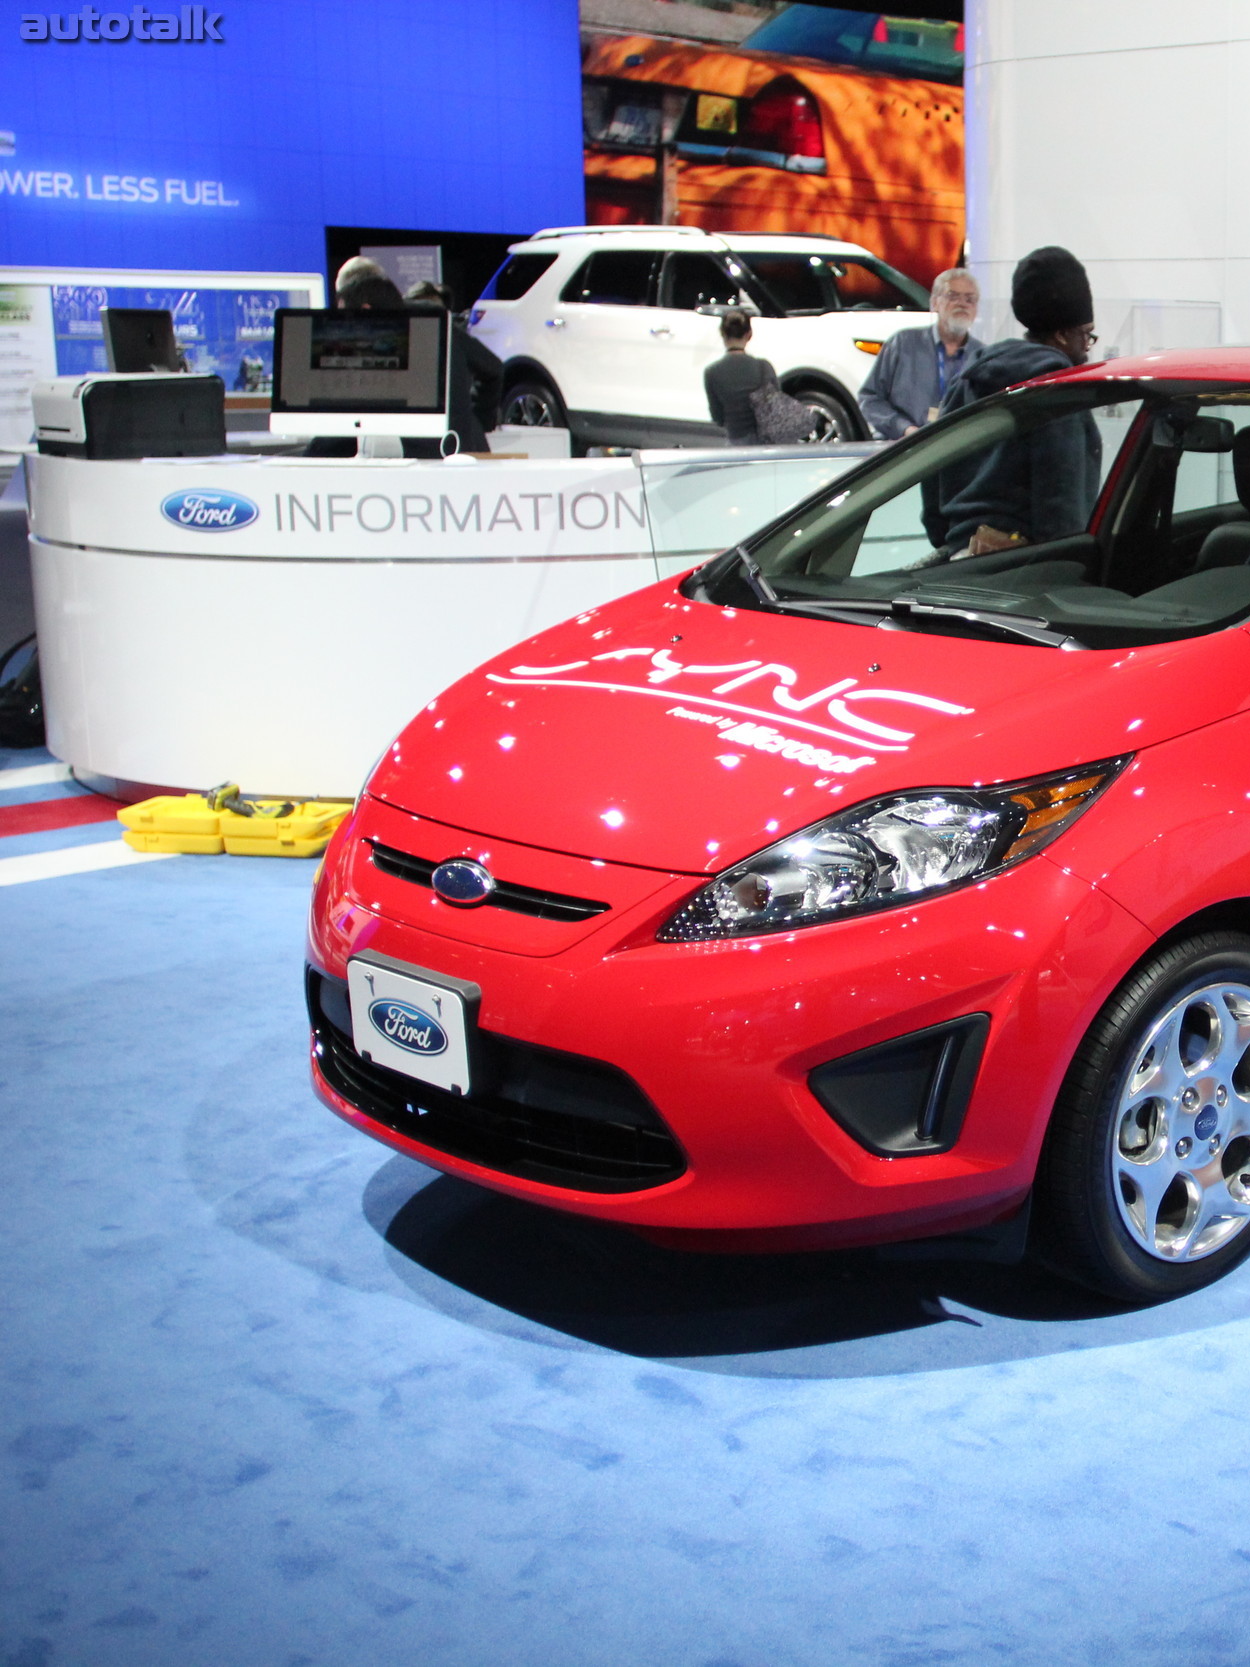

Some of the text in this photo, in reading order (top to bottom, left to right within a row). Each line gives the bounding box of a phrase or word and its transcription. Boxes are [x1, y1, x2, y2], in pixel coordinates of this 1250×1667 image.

[0, 169, 240, 207] WER. LESS FUEL.
[178, 491, 647, 532] Ford INFORMATION
[385, 1005, 432, 1049] Ford
